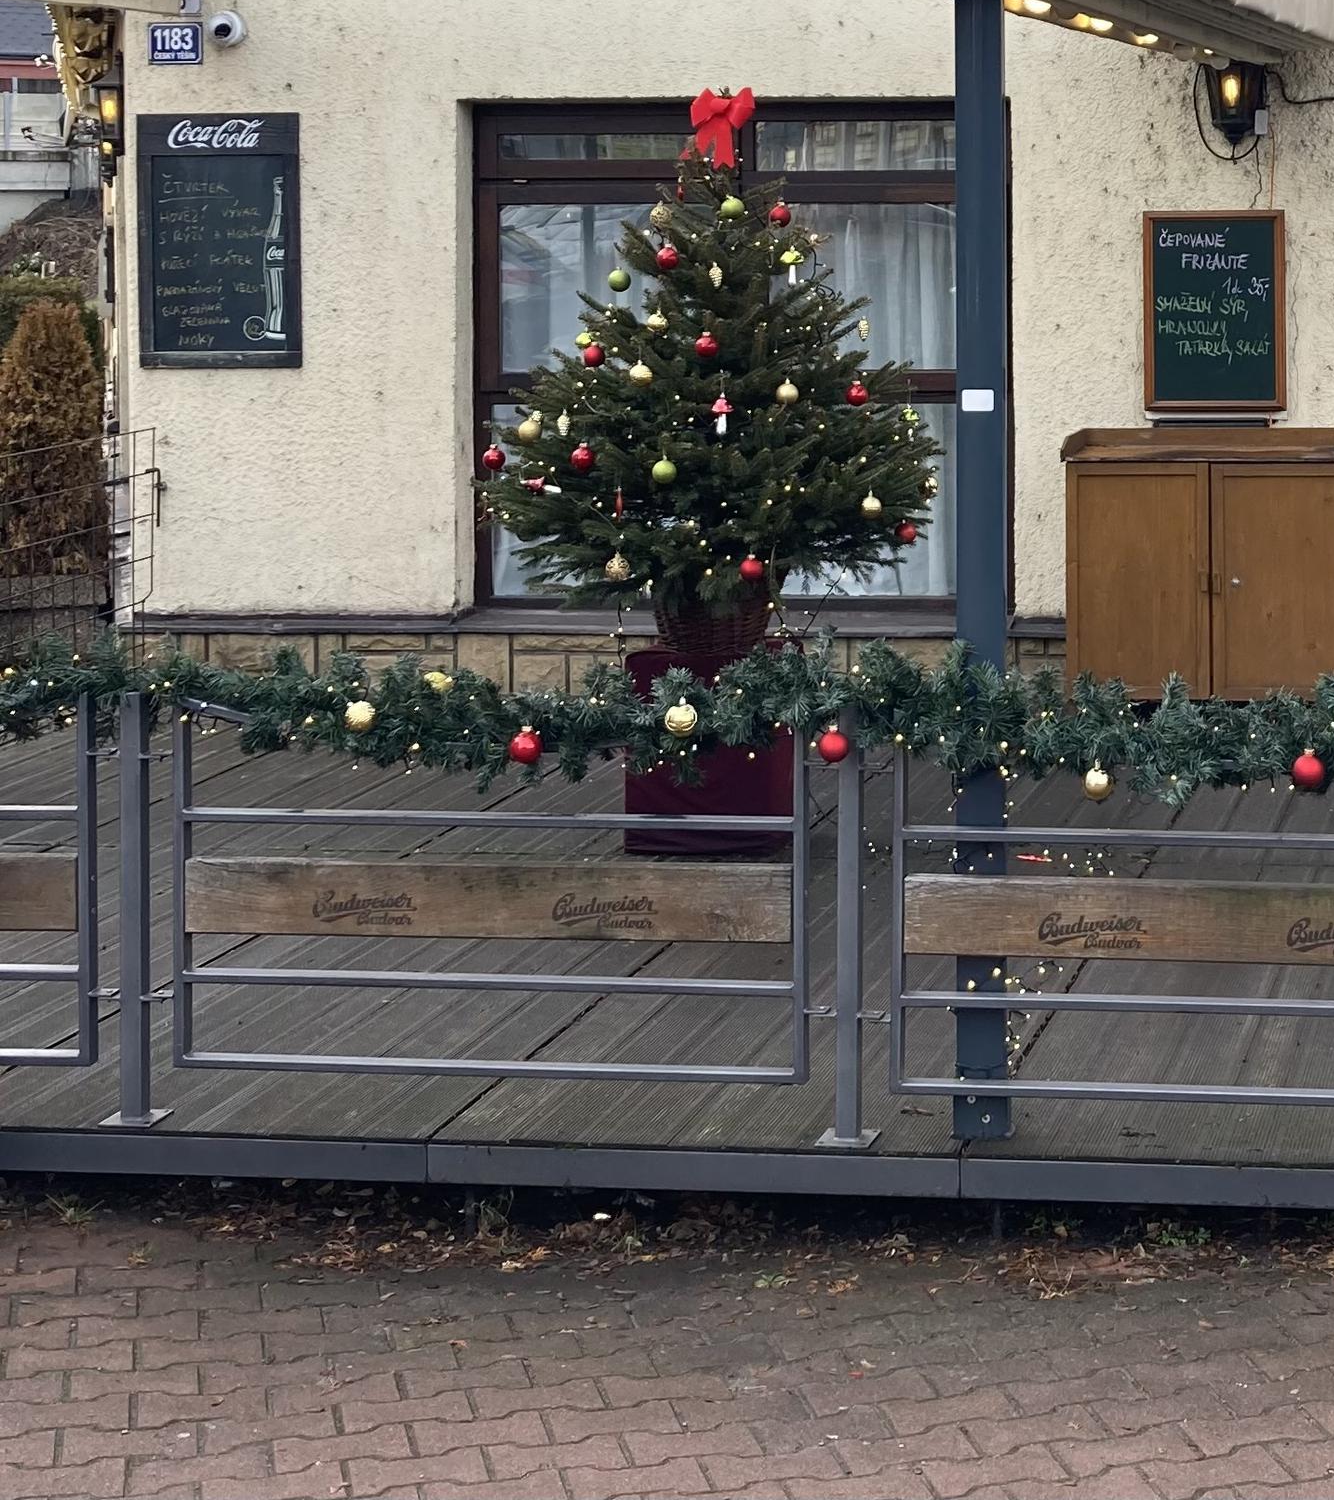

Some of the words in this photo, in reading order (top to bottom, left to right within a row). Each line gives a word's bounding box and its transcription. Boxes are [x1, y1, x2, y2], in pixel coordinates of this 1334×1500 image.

[153, 27, 193, 50] 1183
[167, 119, 265, 148] Coca-Cola
[1158, 227, 1229, 248] ČEPOVANÉ
[552, 891, 658, 923] Budweiser
[1038, 911, 1147, 943] Budweiser
[1084, 931, 1143, 949] Budvar
